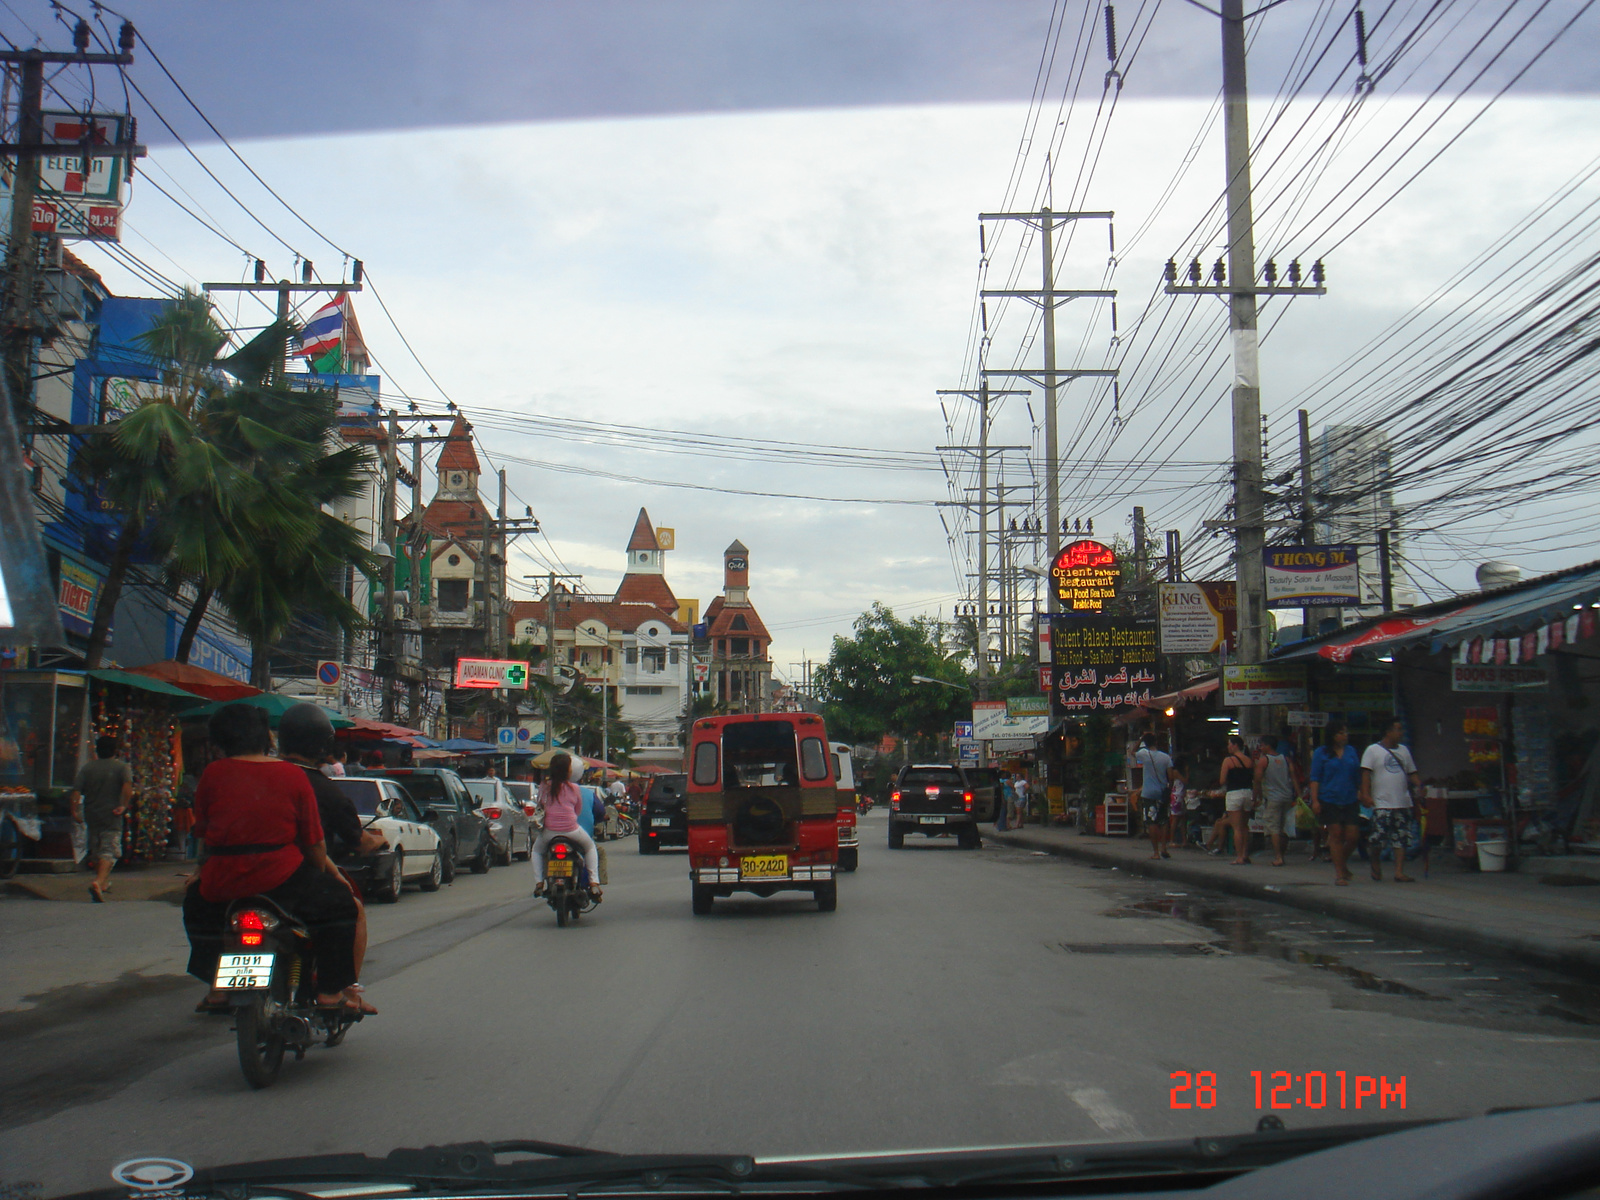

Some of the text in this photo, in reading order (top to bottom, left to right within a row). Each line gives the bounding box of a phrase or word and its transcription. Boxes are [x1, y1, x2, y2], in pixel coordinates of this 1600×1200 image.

[48, 158, 103, 172] ELEVn
[59, 210, 86, 229] 24
[1272, 552, 1349, 567] THONG M.
[1053, 568, 1092, 577] Orient
[1059, 576, 1114, 587] Restaurant
[1269, 576, 1292, 585] Beauty
[1294, 575, 1312, 583] Salon
[1324, 574, 1353, 583] Massage
[1074, 589, 1089, 599] Food
[1090, 589, 1100, 598] Sea
[1101, 588, 1115, 598] Food
[1162, 593, 1202, 605] KING
[1090, 600, 1102, 609] Food
[1219, 599, 1236, 607] KIN
[1055, 627, 1156, 648] Orient Palace Restaurant
[1056, 648, 1155, 665] Thai Food Sea Food Arabic Food
[463, 665, 505, 680] ANDAMAN CLINIC
[696, 665, 707, 680] 7
[1100, 666, 1128, 688] قصر
[1455, 668, 1495, 681] BOOKS
[1042, 675, 1052, 685] M
[1058, 668, 1097, 690] الشرق
[743, 860, 784, 872] 30-2420
[228, 976, 256, 987] 445
